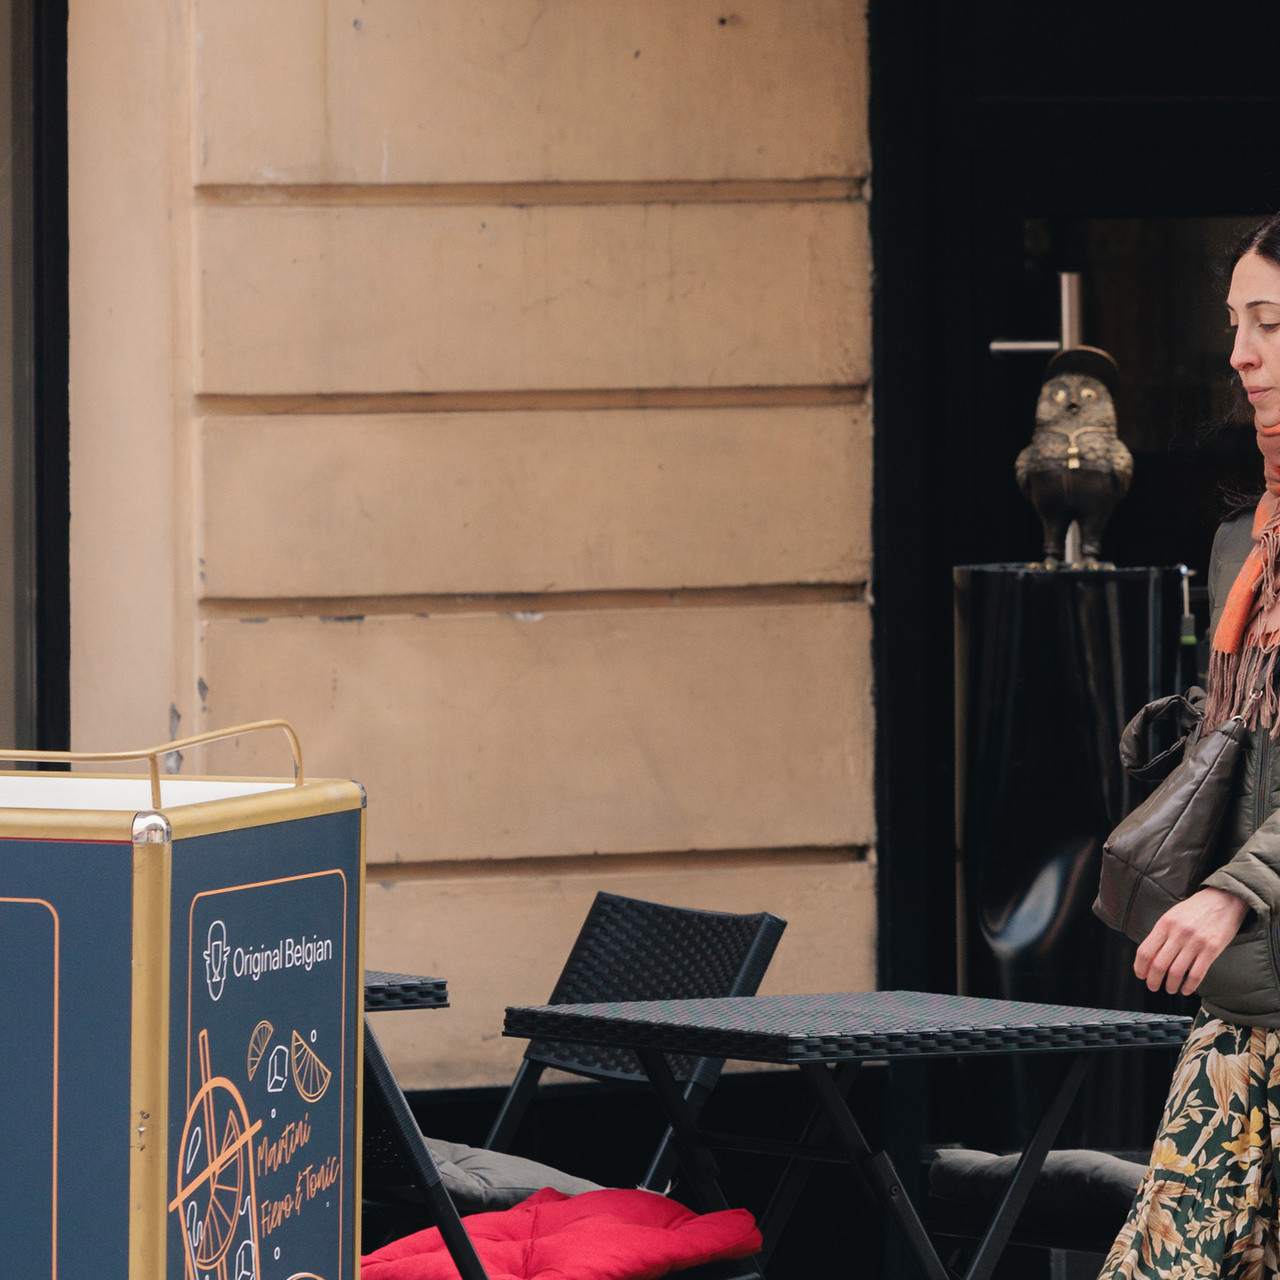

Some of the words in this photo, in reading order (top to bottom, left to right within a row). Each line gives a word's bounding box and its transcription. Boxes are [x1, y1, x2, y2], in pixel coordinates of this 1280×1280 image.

[233, 940, 283, 982] Original
[285, 934, 333, 972] Belgian
[257, 1111, 312, 1177] Martini
[260, 1193, 295, 1239] Fiero
[302, 1156, 340, 1201] Tonic
